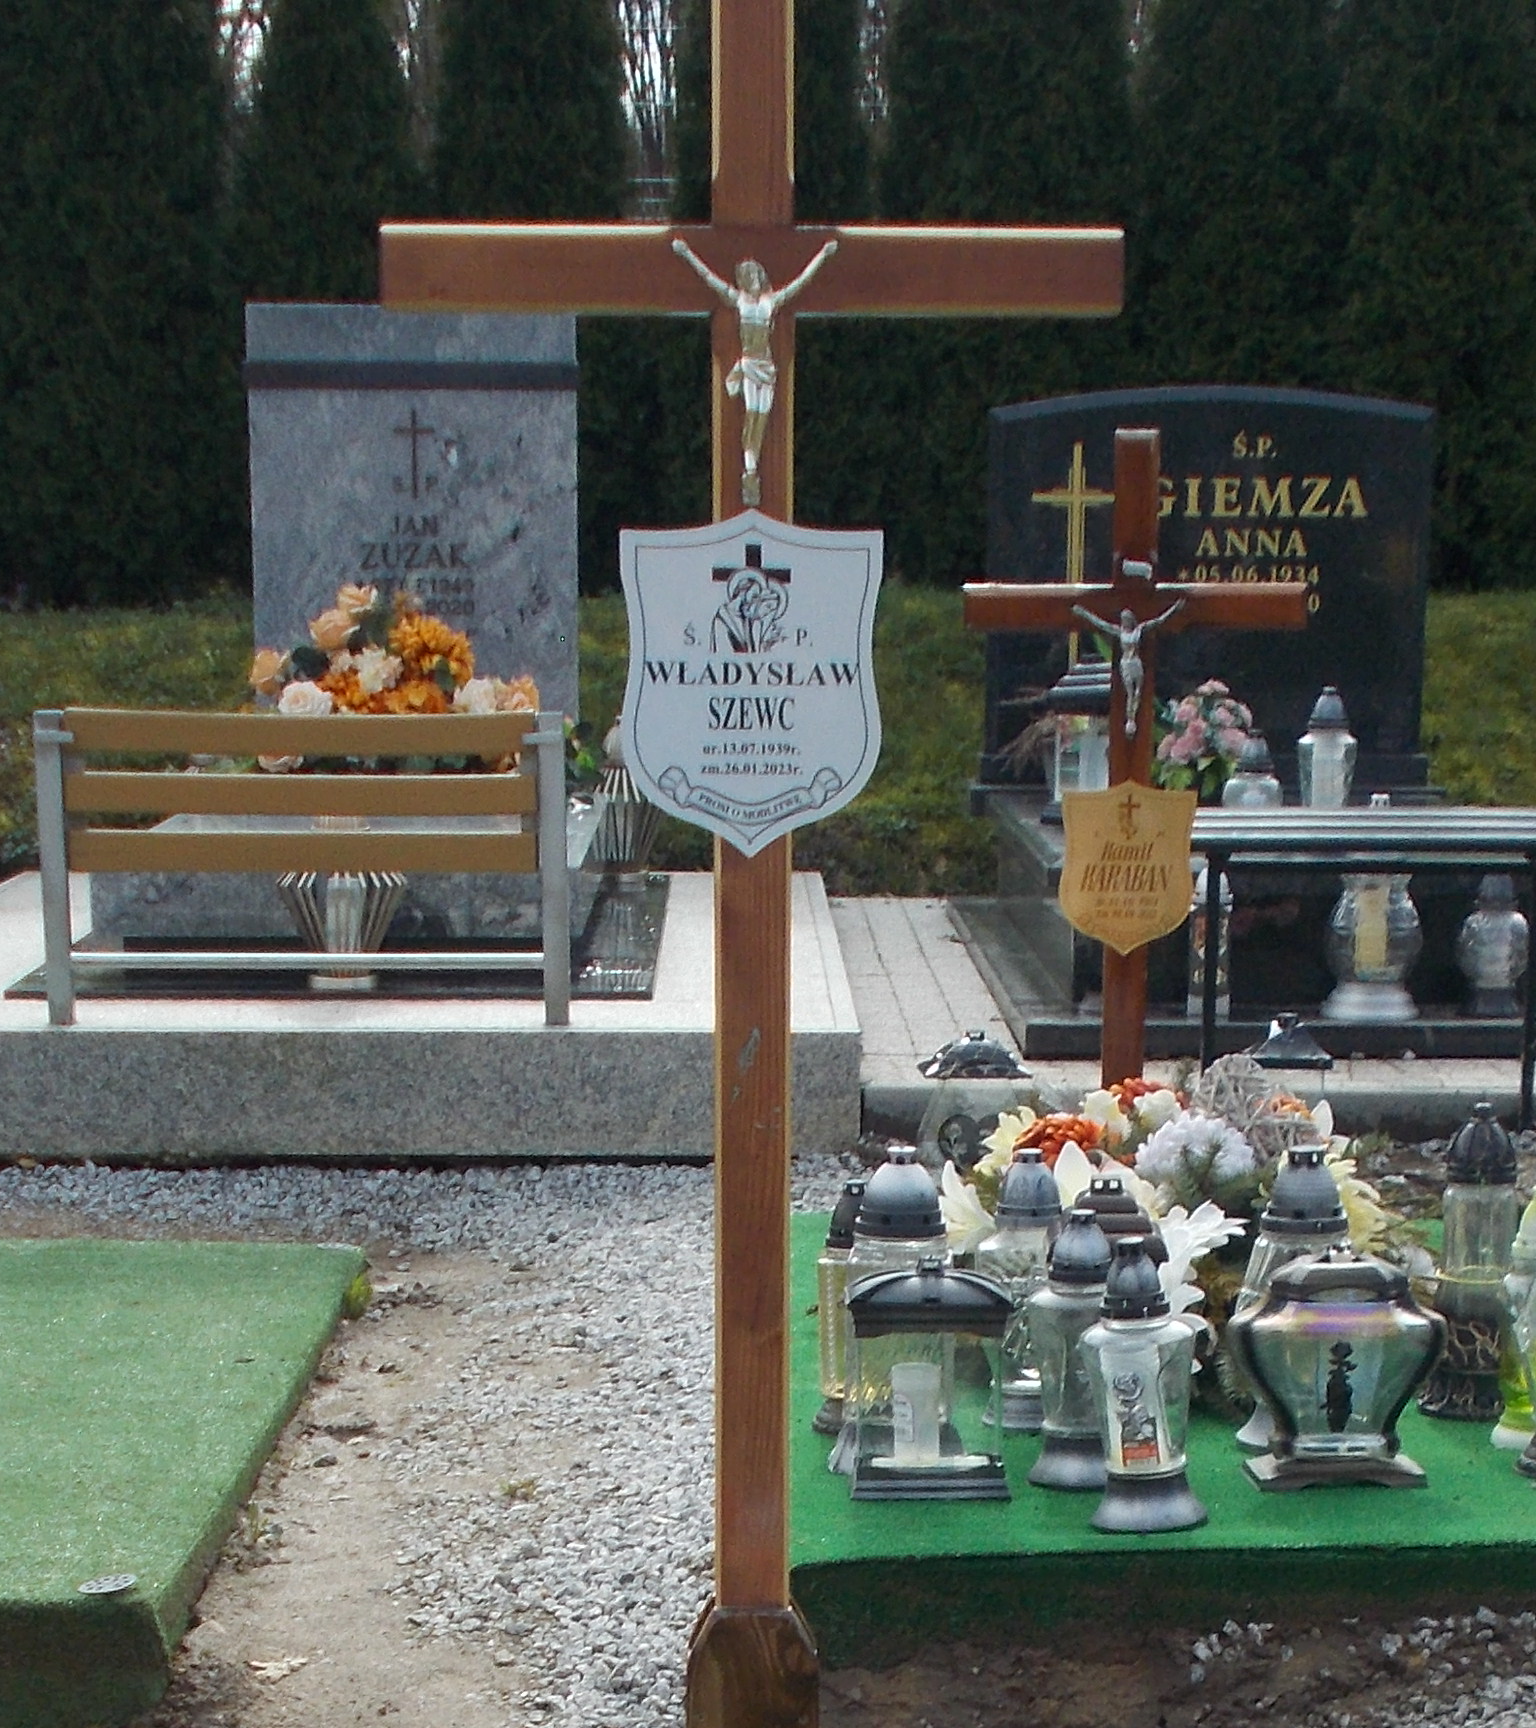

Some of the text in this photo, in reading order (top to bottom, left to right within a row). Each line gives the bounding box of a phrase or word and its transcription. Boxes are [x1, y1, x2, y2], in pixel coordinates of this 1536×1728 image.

[389, 514, 441, 537] JAN
[360, 541, 470, 570] ZUZAK
[1195, 528, 1309, 558] ANNA
[644, 660, 860, 687] WŁADYSŁAW
[707, 696, 796, 731] SZEWC
